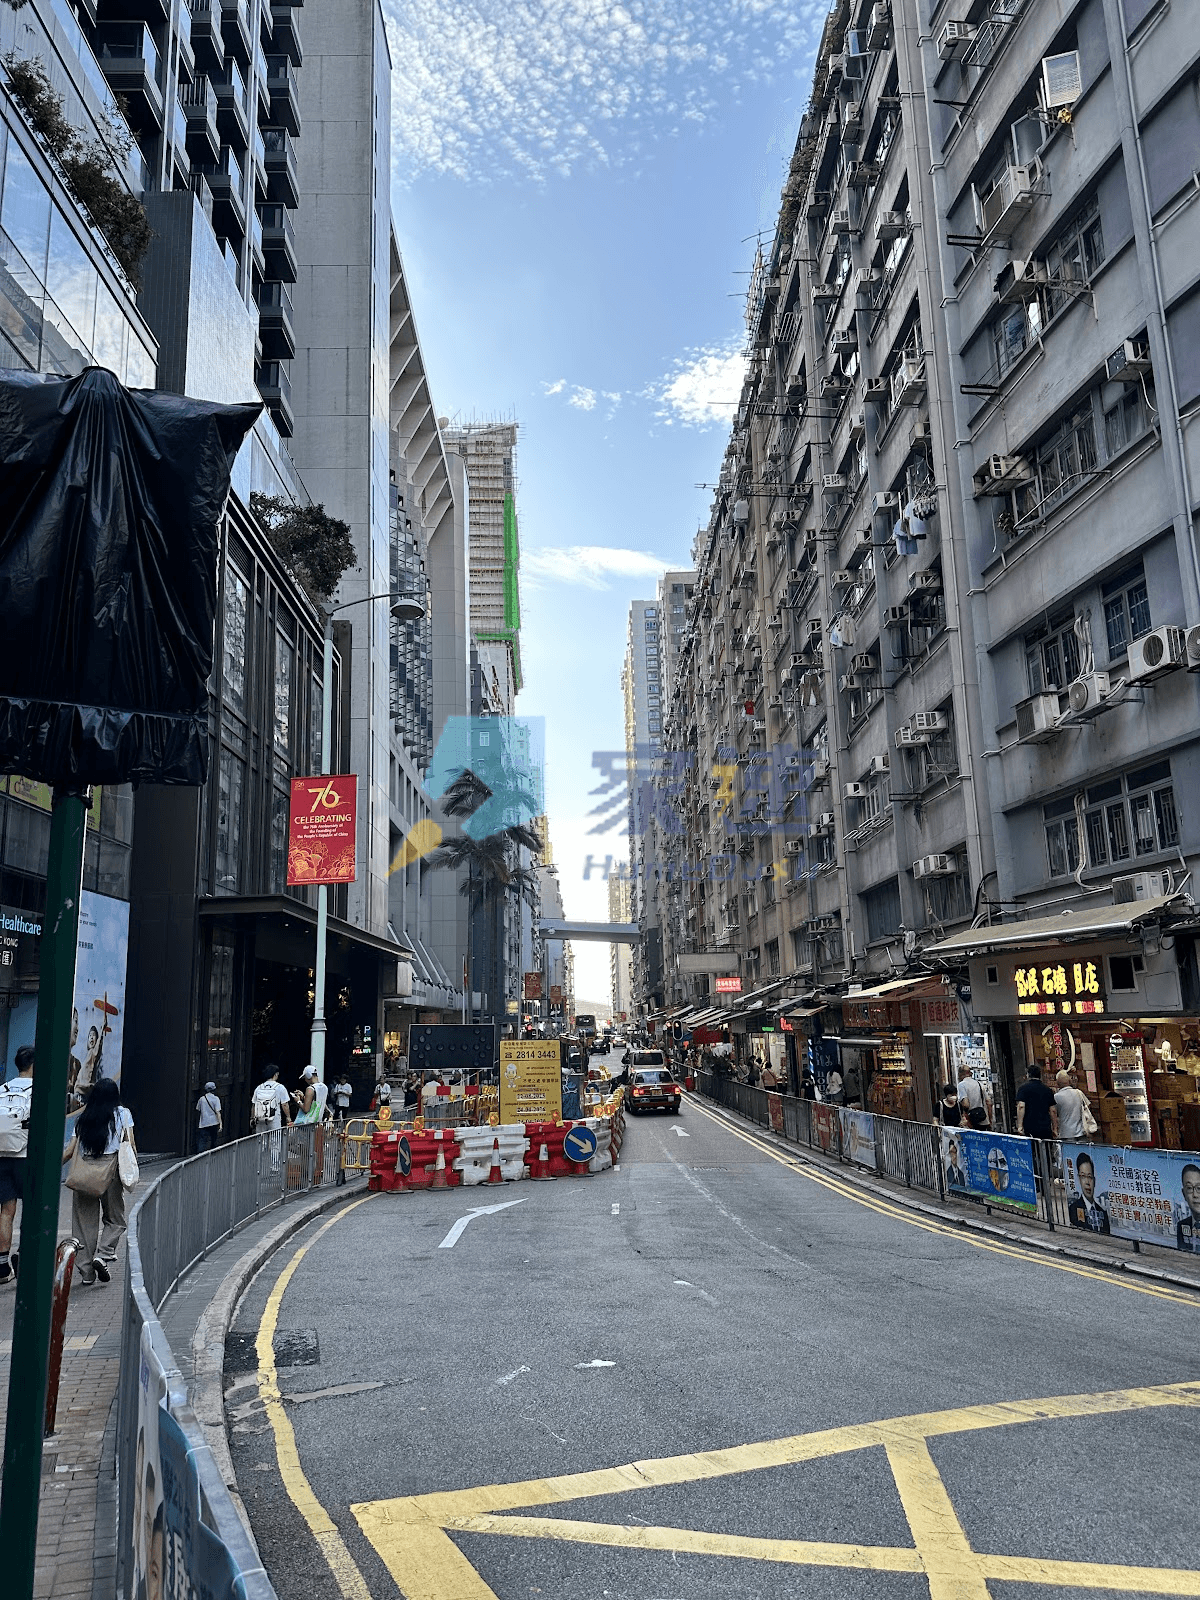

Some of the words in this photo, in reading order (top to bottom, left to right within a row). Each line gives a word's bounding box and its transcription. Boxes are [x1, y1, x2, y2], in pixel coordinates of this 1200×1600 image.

[307, 780, 339, 813] 76
[294, 814, 352, 825] CELEBRATING
[516, 1051, 535, 1059] 2814
[538, 1051, 556, 1059] 3443
[1111, 1166, 1160, 1182] 全民國家安全
[1136, 1181, 1162, 1195] 教育日
[1108, 1192, 1172, 1212] 全民國家安全教育
